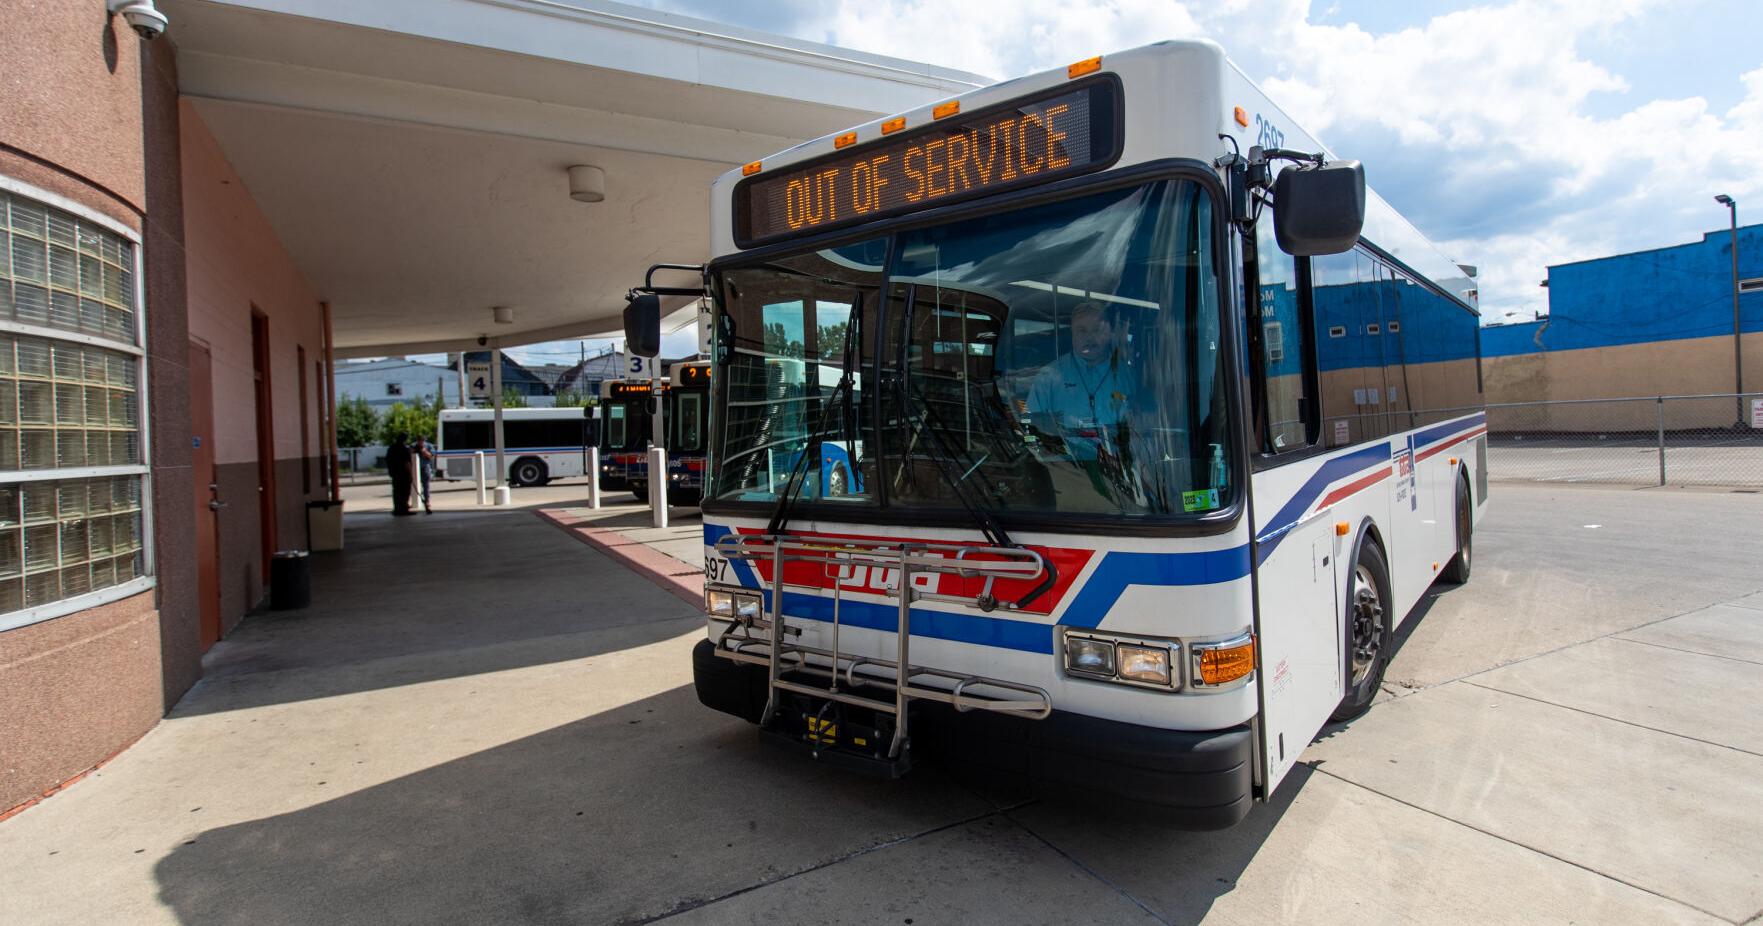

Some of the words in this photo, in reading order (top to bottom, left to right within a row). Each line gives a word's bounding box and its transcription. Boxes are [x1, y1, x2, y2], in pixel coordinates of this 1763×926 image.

[786, 169, 839, 230] OUT
[852, 155, 889, 215] OF
[903, 104, 1071, 202] SERVICE
[631, 357, 643, 373] 3
[473, 376, 486, 391] 4
[705, 555, 728, 581] 697
